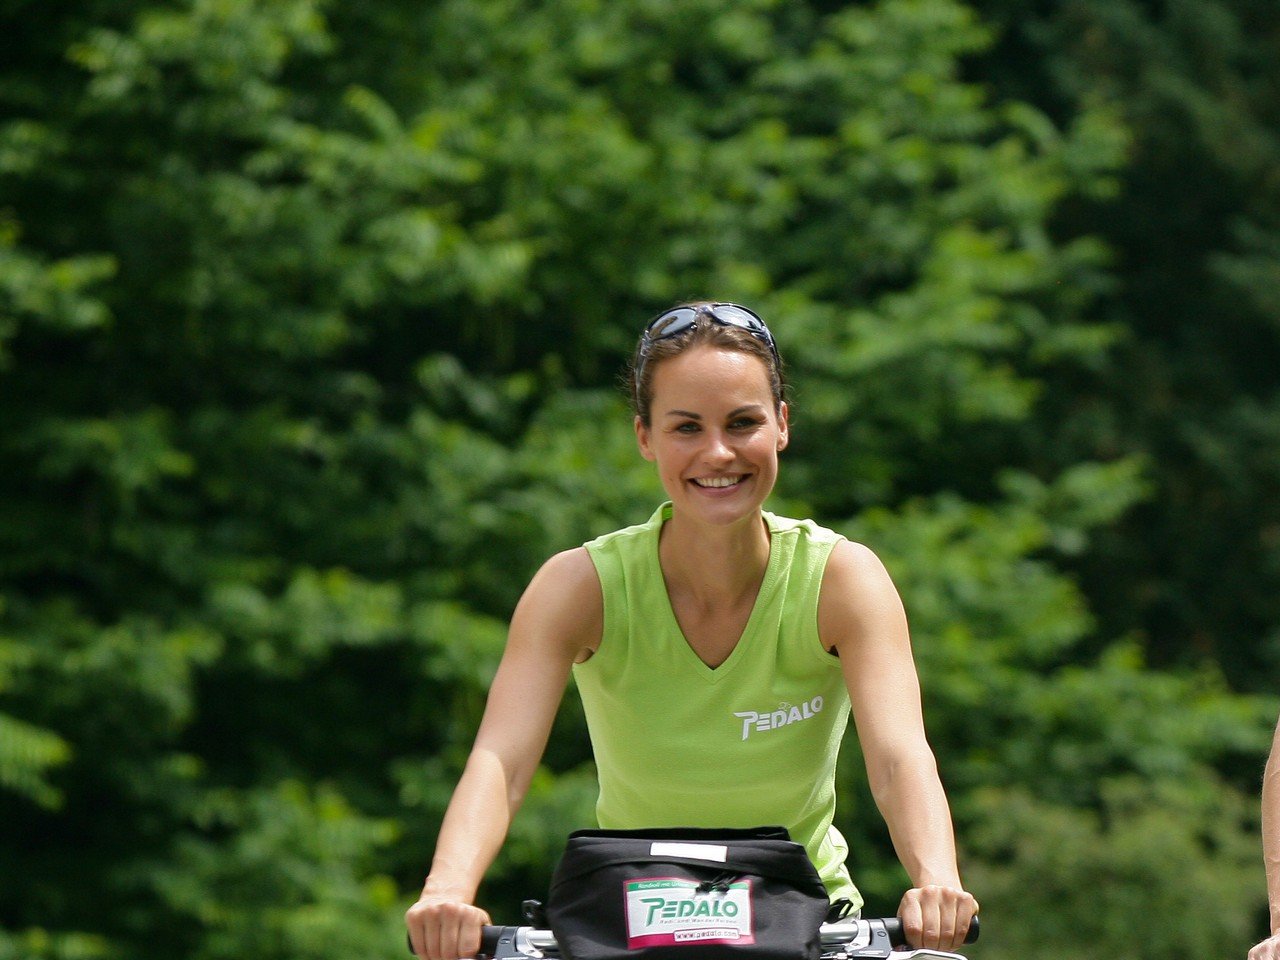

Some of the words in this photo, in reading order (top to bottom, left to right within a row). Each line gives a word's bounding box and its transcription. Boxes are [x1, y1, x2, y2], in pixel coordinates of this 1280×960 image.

[733, 695, 824, 741] PEDALO
[639, 897, 739, 927] PEDALO
[675, 931, 738, 940] www.pedalo.com
